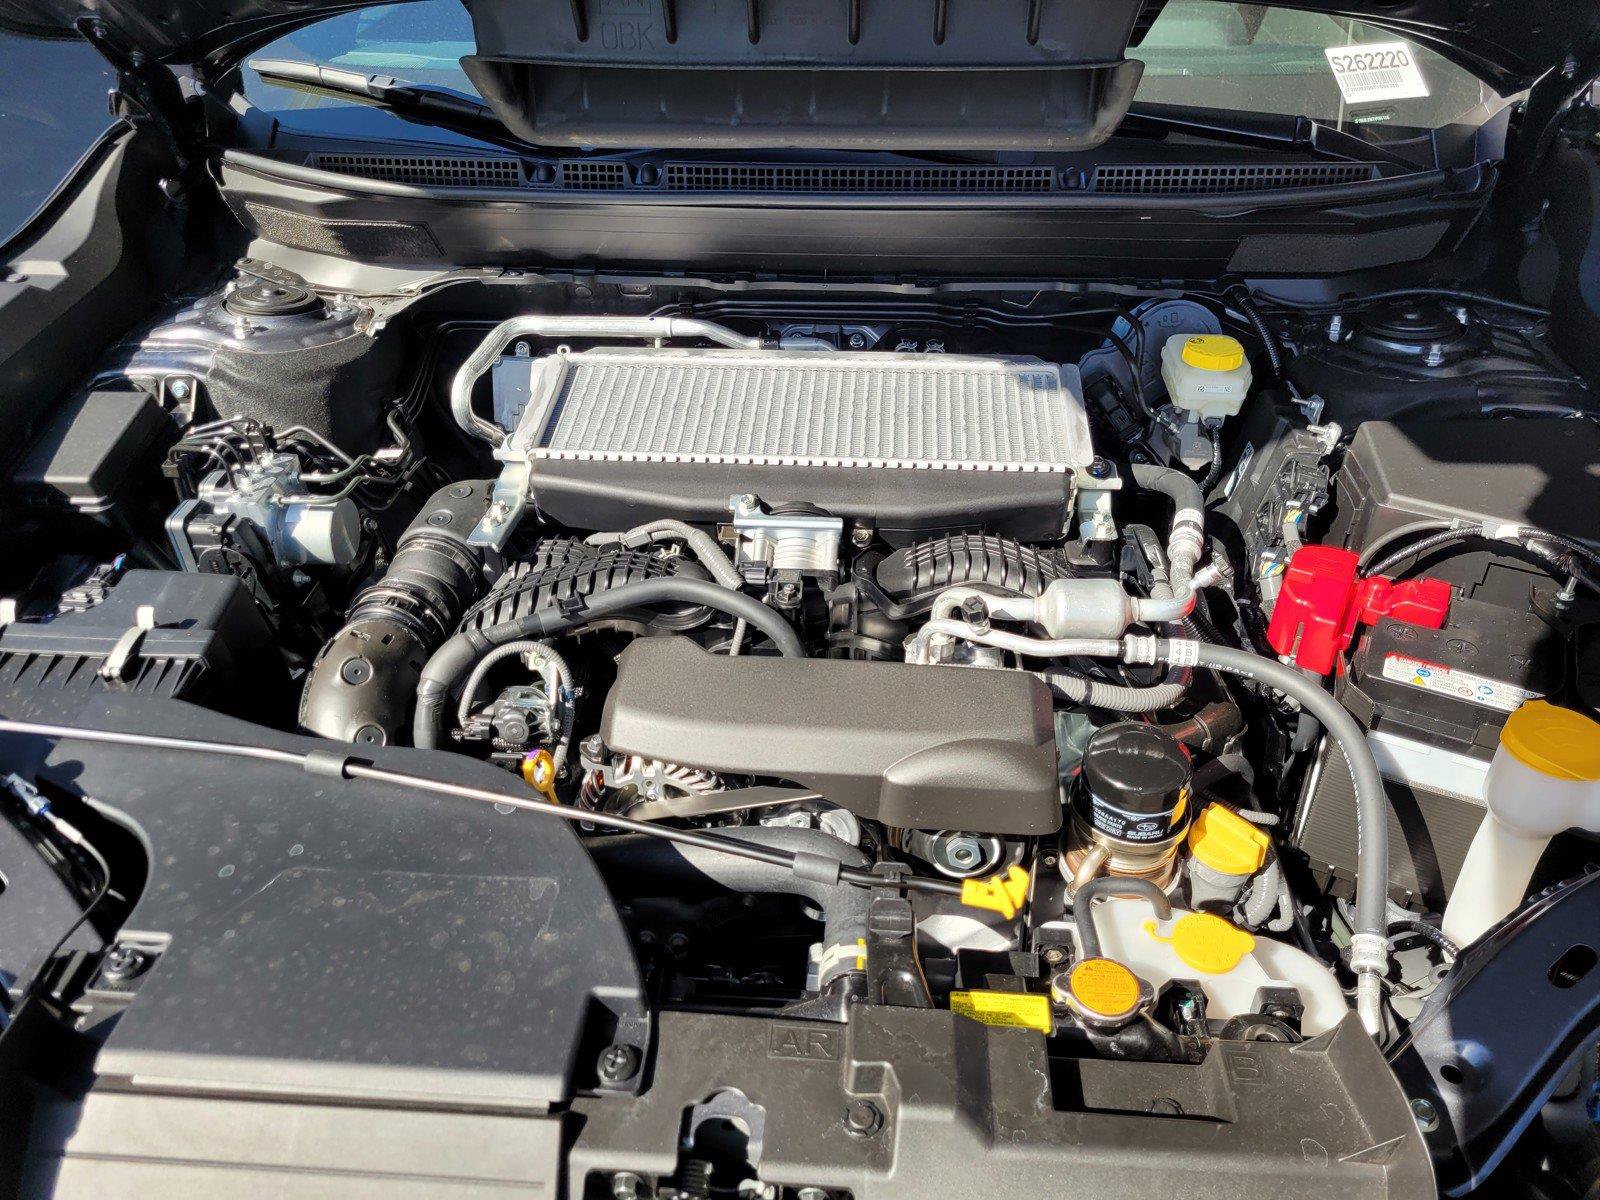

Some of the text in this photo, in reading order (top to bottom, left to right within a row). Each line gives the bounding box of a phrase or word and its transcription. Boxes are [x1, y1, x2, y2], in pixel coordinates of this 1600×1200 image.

[1331, 50, 1410, 73] S262220
[1127, 828, 1164, 837] SUBARU
[773, 1029, 832, 1057] AR
